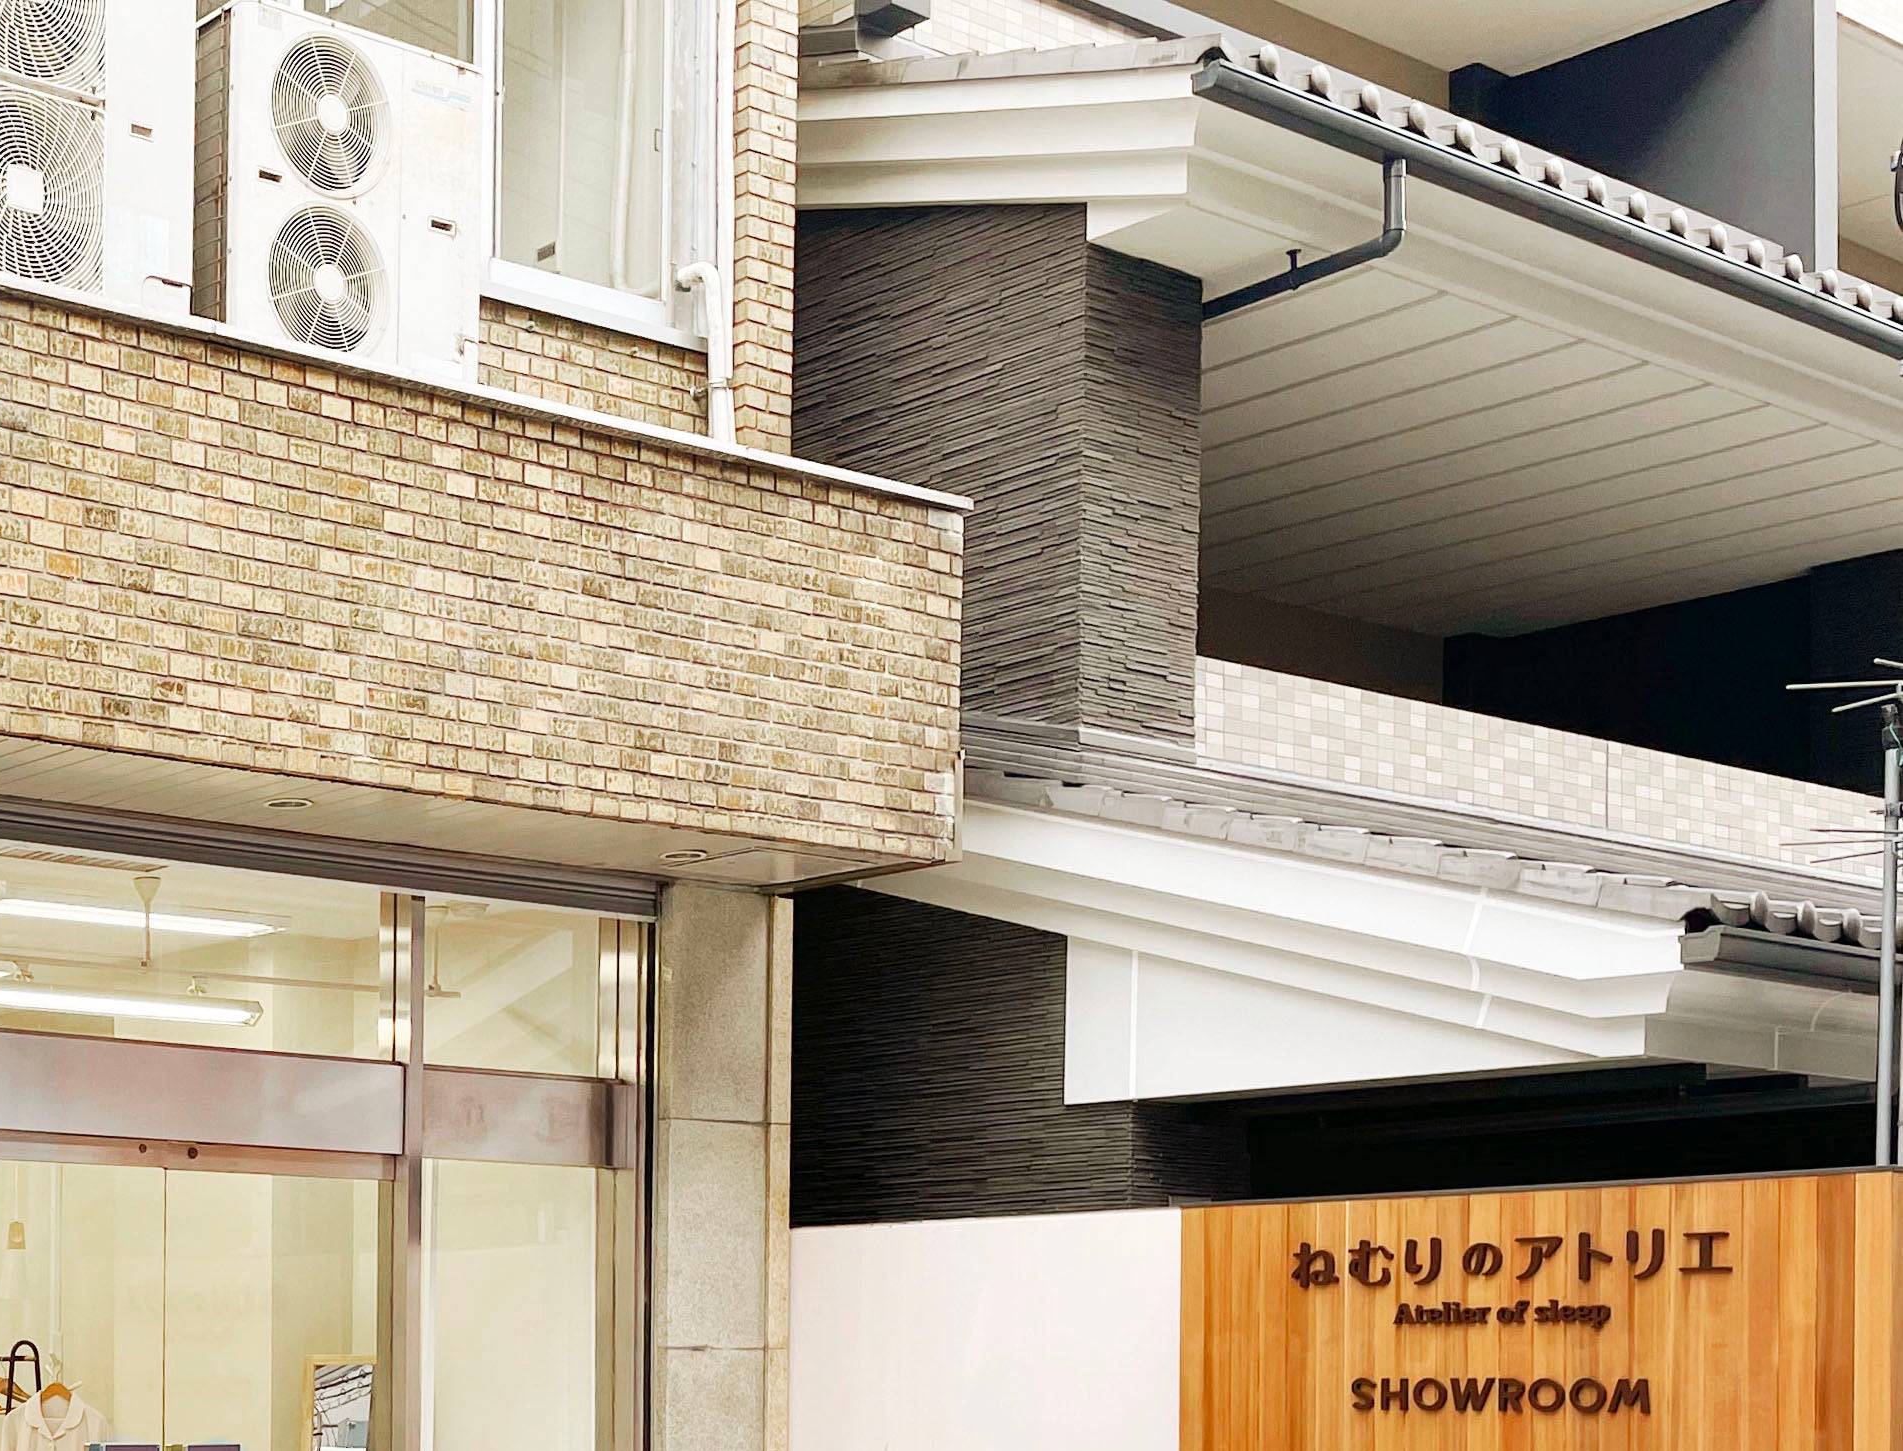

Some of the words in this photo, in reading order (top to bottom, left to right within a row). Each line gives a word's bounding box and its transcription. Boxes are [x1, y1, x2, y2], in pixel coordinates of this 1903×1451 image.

[1291, 1228, 1733, 1289] ねむりのアトリエ
[1393, 1302, 1491, 1326] Atelier
[1496, 1300, 1530, 1325] of
[1534, 1299, 1611, 1331] sleep
[1350, 1377, 1651, 1415] SHOWROOM
